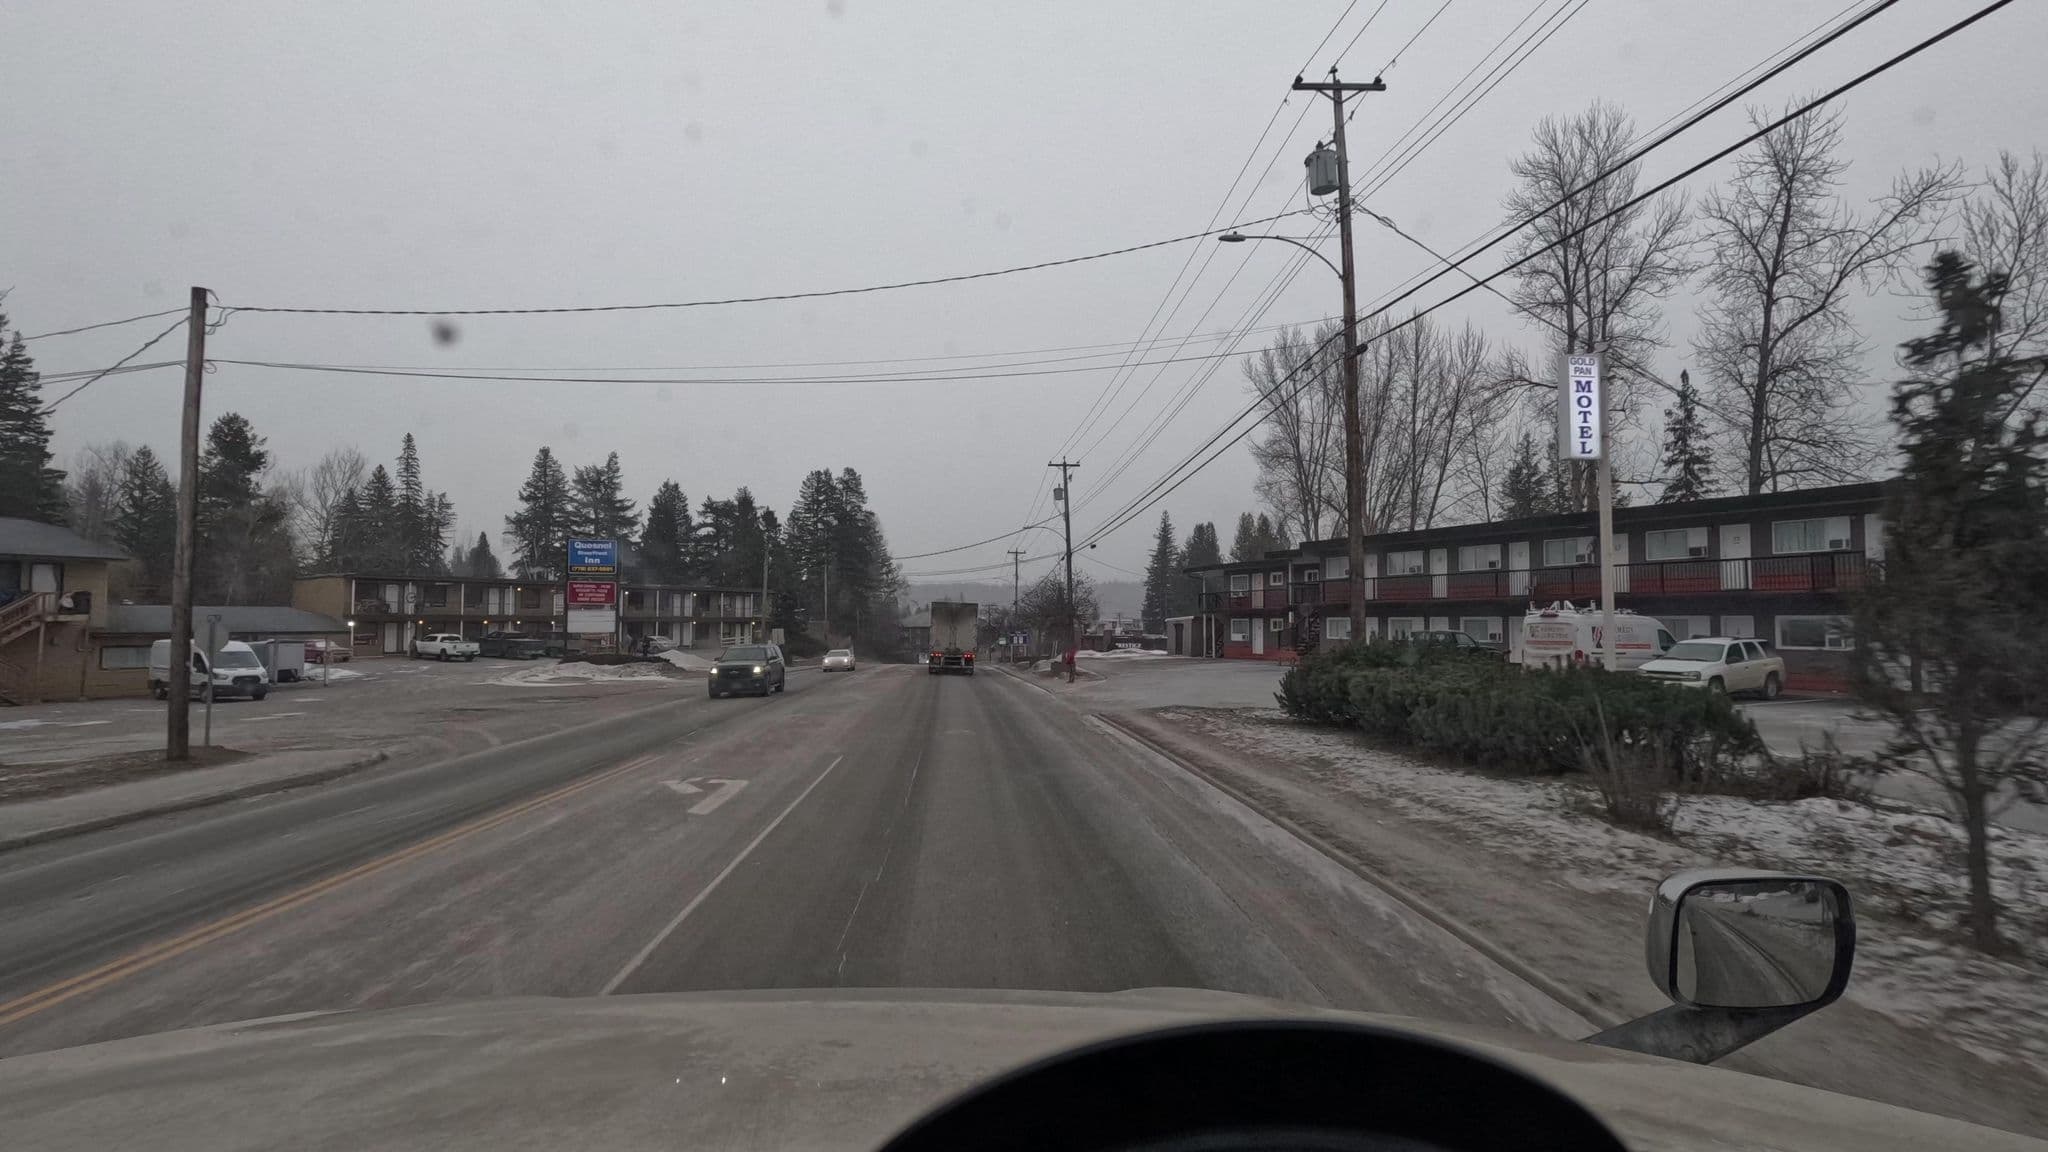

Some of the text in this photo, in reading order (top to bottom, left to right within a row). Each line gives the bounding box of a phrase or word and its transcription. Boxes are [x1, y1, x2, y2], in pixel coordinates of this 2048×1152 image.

[1570, 357, 1595, 366] GOLD
[1574, 366, 1592, 375] PAN
[1574, 380, 1593, 454] MOTEL
[584, 556, 600, 564] Inn
